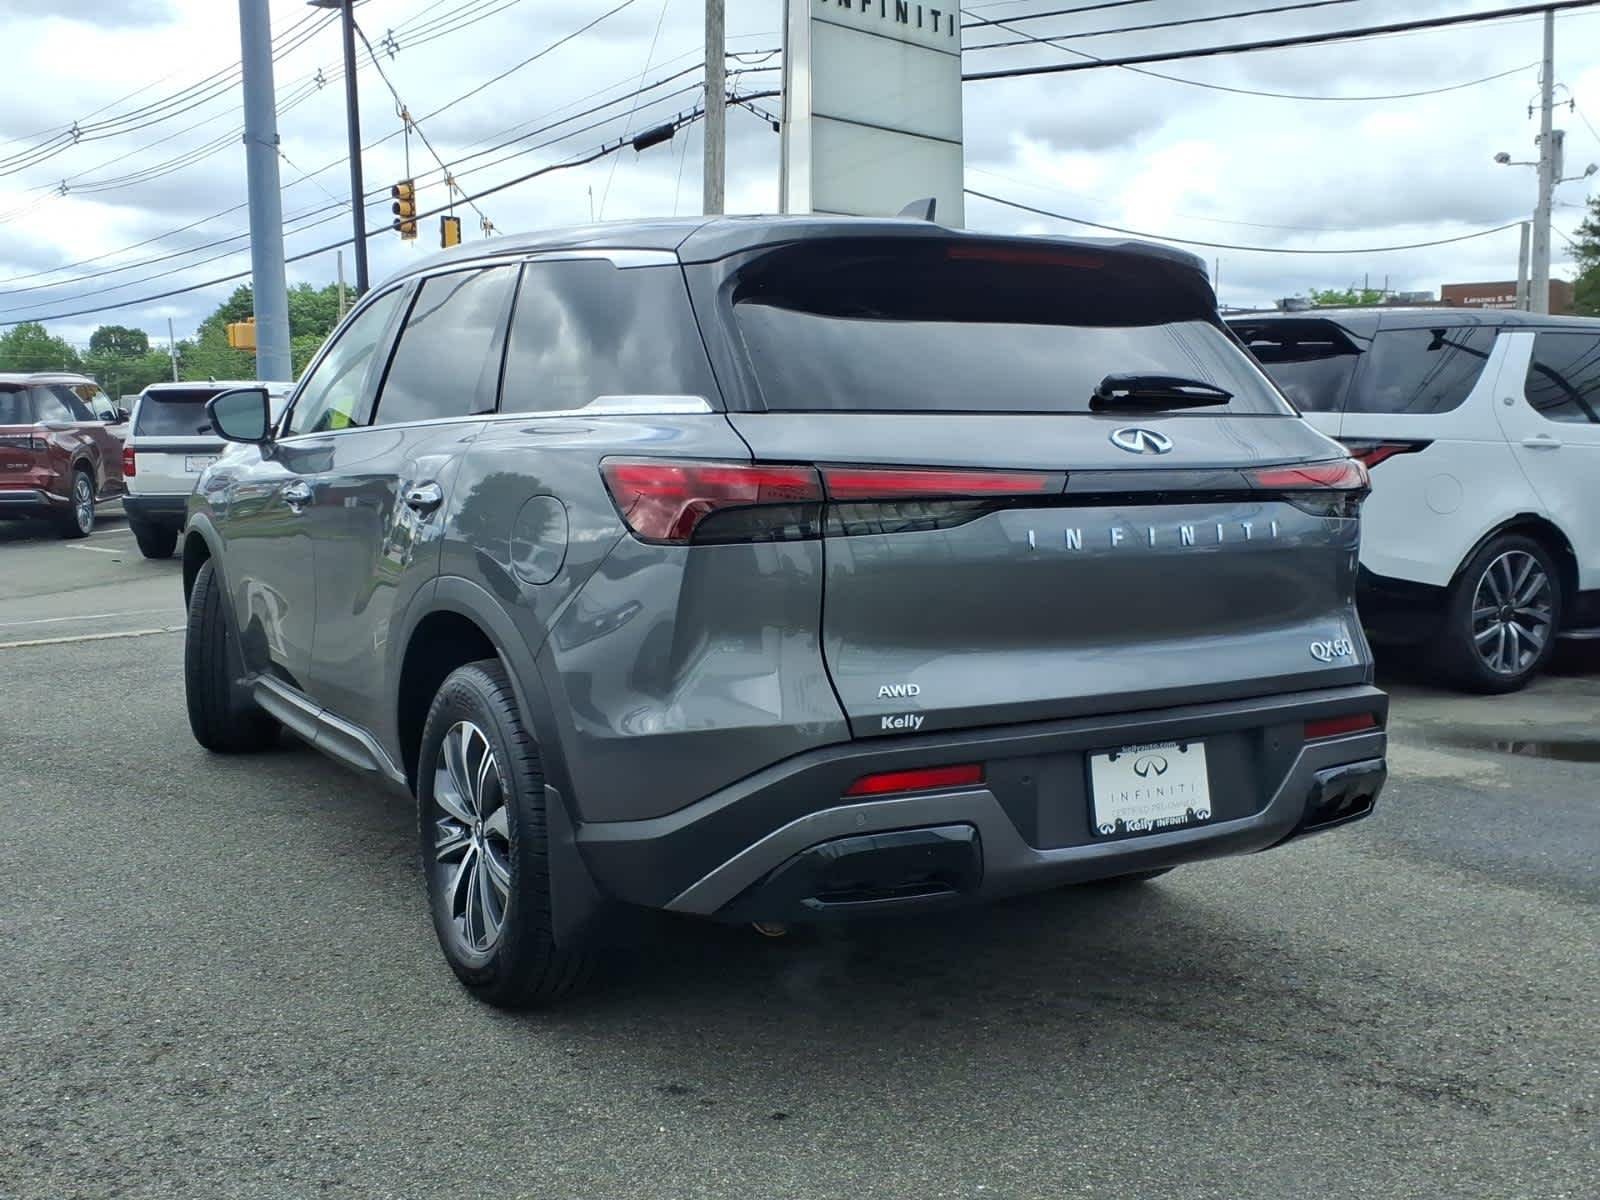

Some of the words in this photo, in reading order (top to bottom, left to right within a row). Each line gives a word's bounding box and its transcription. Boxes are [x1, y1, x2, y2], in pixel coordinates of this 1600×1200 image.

[822, 0, 954, 37] FINITI
[1027, 521, 1279, 550] INFINITI
[1310, 639, 1353, 662] QX60
[878, 683, 921, 698] AWD
[881, 714, 925, 730] Kelly
[1111, 783, 1195, 803] INFINITI
[1125, 818, 1153, 832] Kelly
[1156, 815, 1188, 828] INFINITI
